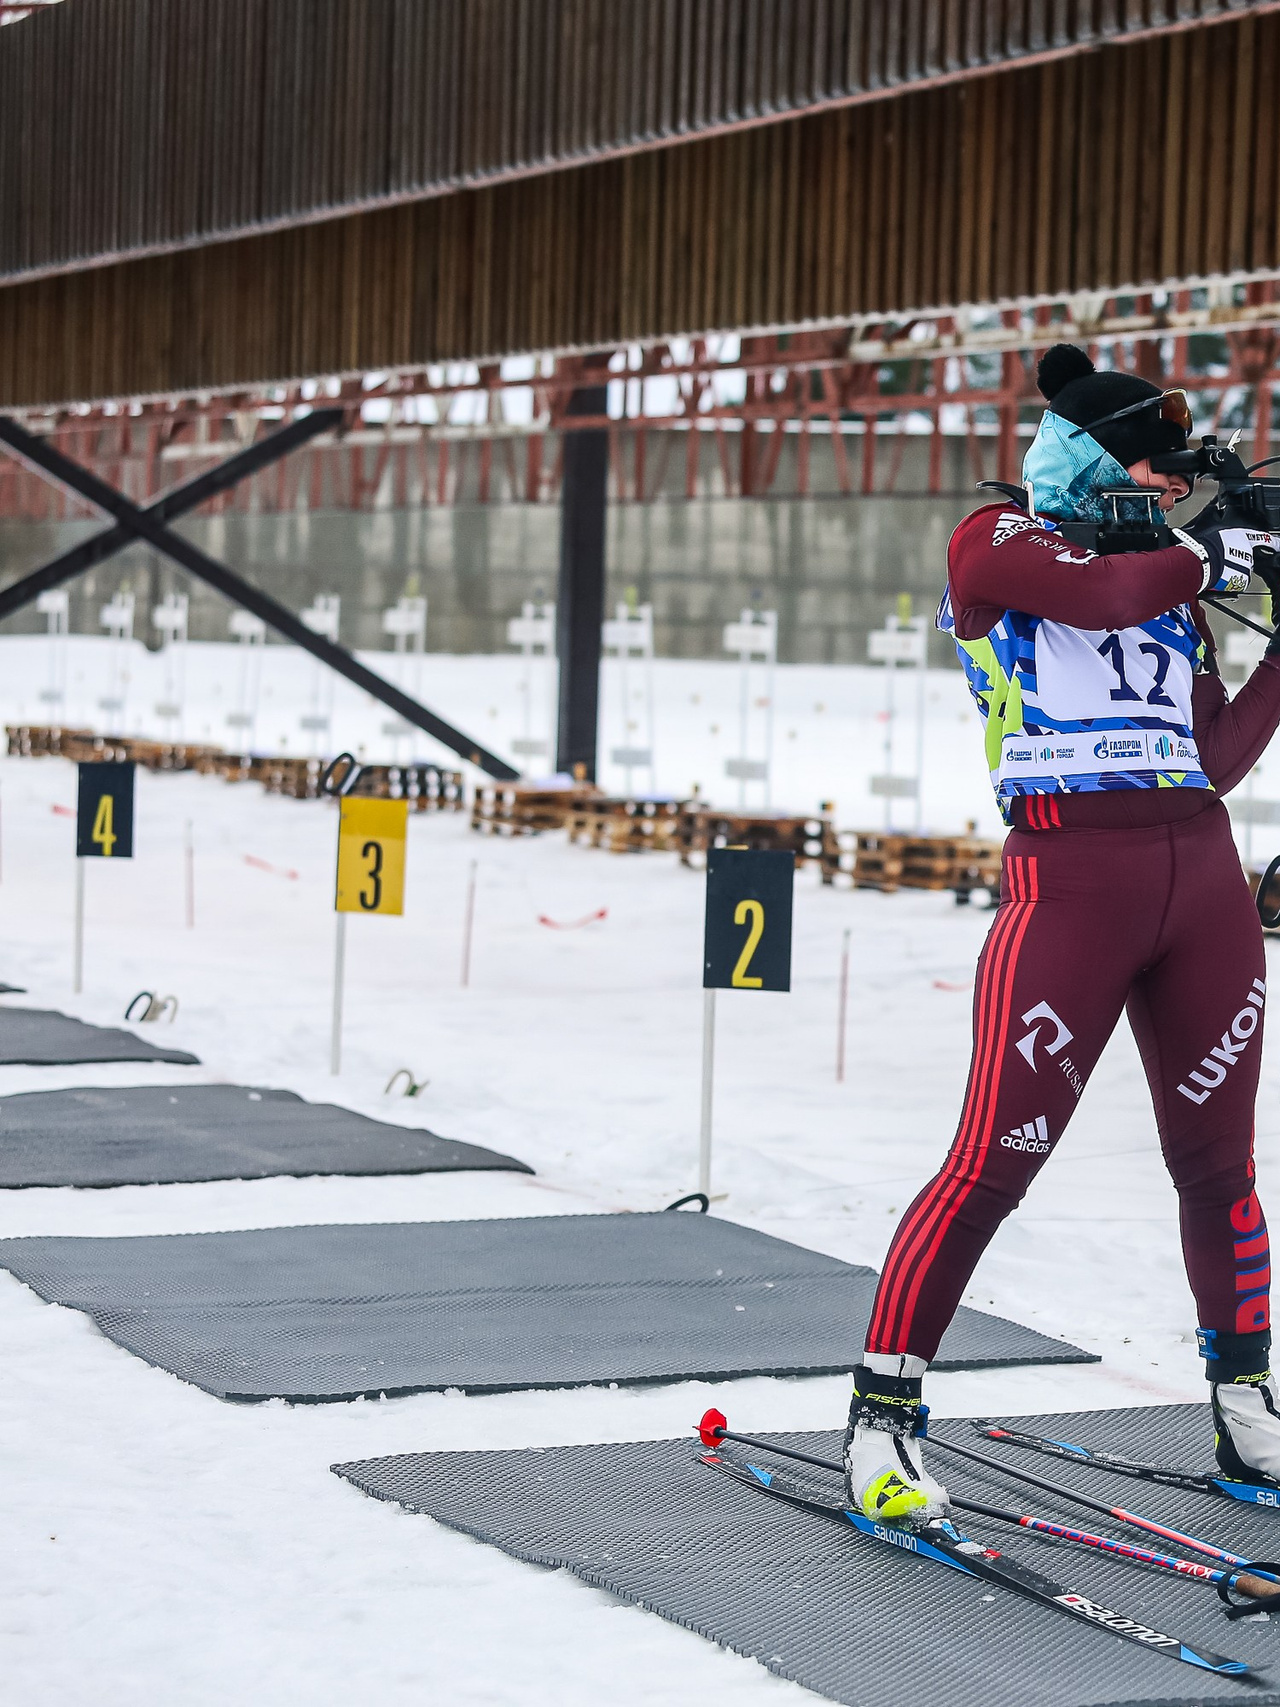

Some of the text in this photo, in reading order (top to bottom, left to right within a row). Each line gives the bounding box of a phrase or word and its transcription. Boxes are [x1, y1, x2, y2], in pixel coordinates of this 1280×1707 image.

[1097, 633, 1177, 708] 12
[1109, 740, 1142, 751] ГАЗПРОМ
[92, 794, 117, 857] 4
[359, 840, 383, 911] 3
[732, 898, 765, 989] 2
[1000, 1135, 1051, 1153] adidas
